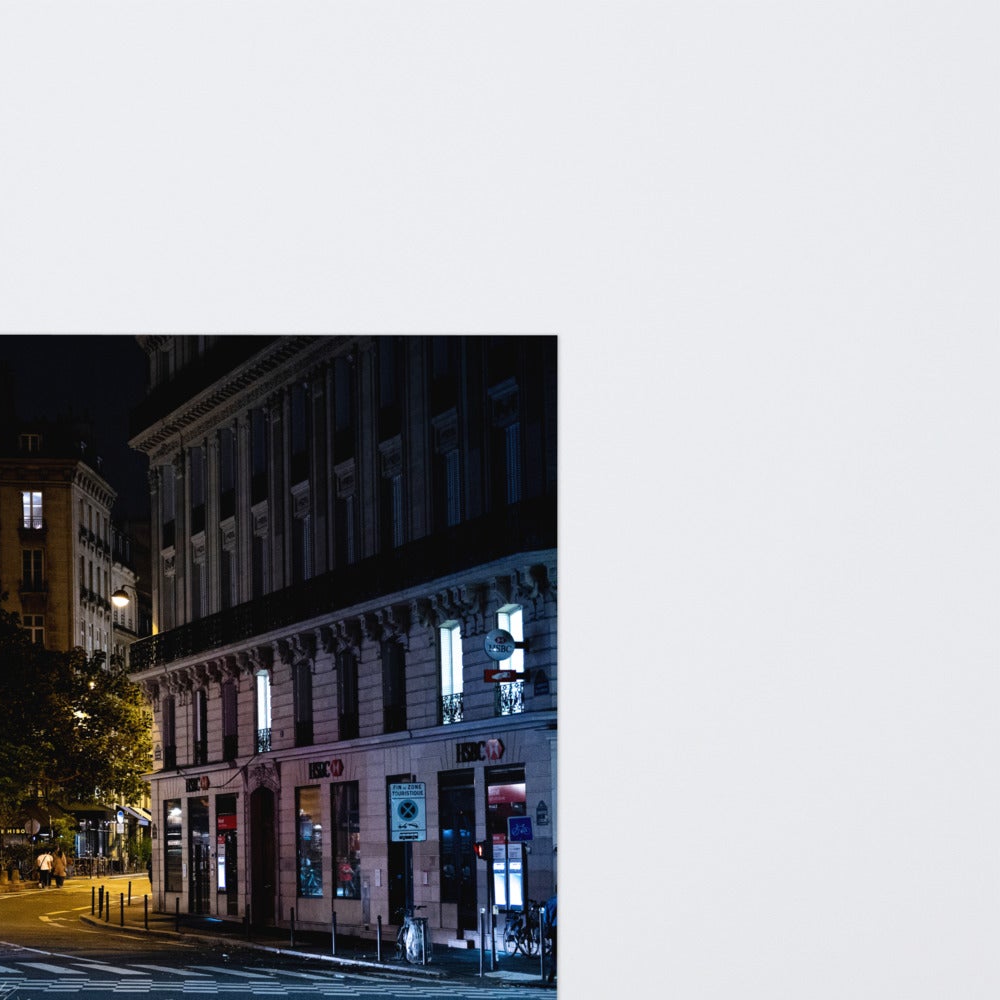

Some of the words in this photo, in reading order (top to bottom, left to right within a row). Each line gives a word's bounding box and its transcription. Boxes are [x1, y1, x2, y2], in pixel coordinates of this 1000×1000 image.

[488, 643, 512, 653] HSBC
[456, 741, 486, 763] HSBC
[309, 761, 330, 779] HSBC
[186, 777, 200, 792] HSBC
